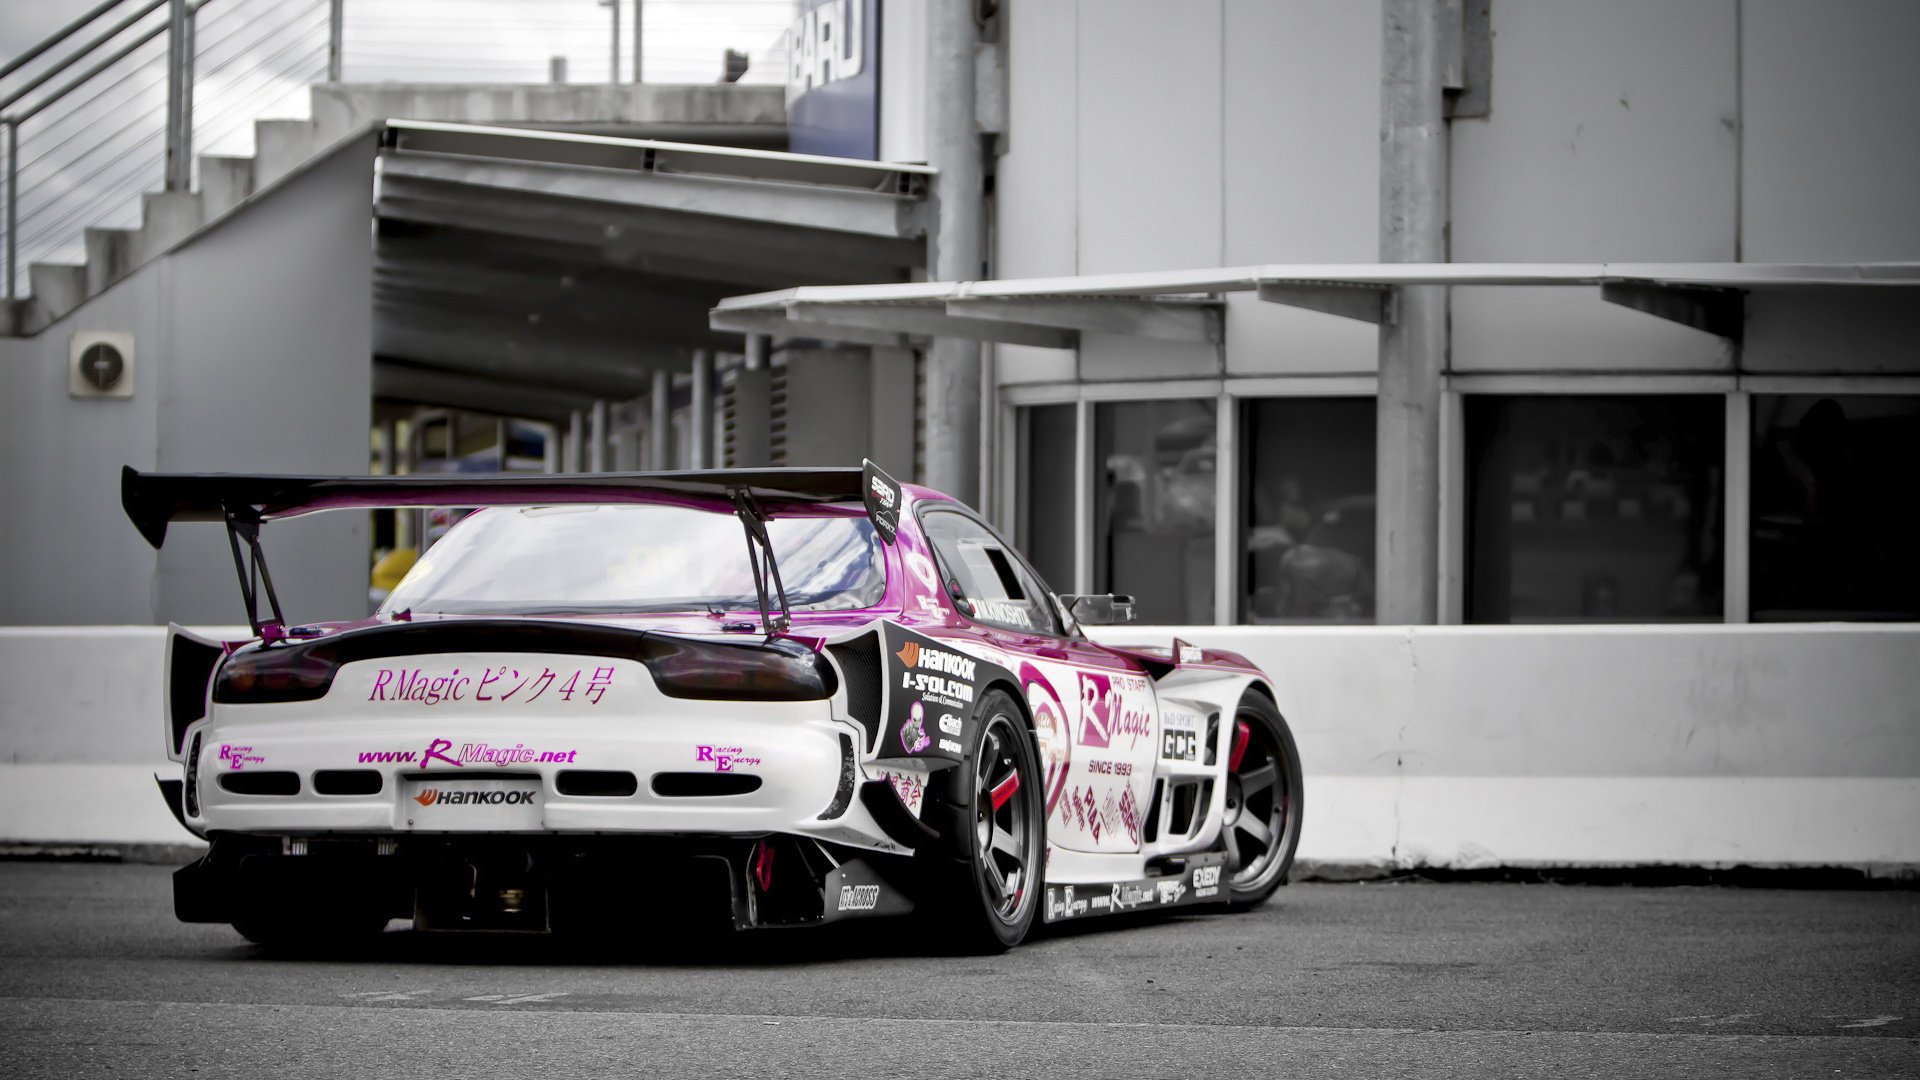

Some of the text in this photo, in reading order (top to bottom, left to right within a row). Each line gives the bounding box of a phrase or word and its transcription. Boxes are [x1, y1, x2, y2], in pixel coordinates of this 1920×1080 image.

[1127, 677, 1146, 692] STAFF
[696, 744, 743, 763] Racing
[1162, 728, 1196, 761] GCG
[715, 754, 761, 772] Energy
[1088, 760, 1132, 776] SINCE 1993
[1084, 785, 1100, 845] PIAA
[1193, 865, 1221, 887] EXEDY
